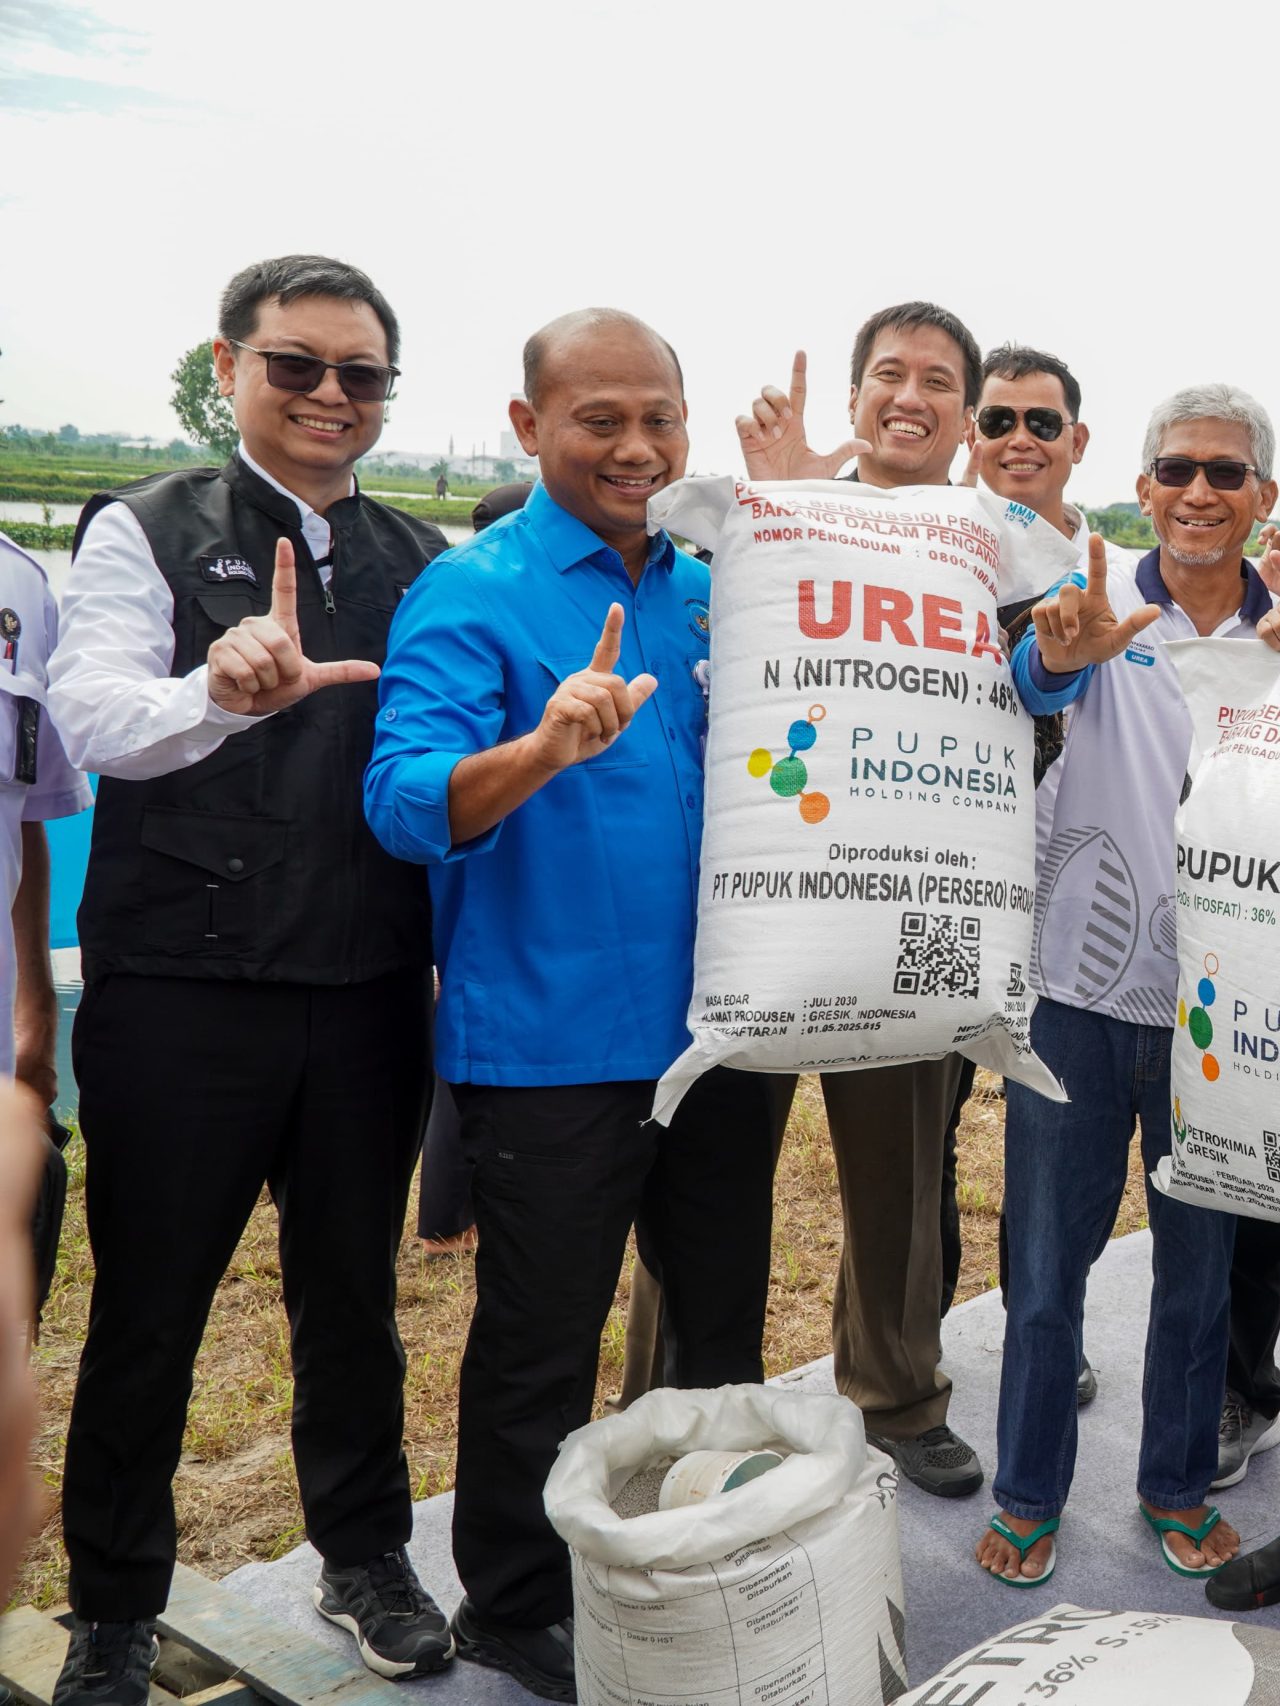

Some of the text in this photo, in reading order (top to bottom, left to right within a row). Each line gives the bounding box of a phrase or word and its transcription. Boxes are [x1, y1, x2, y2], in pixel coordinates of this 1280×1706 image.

[810, 501, 940, 524] BERSUBSIDI
[1007, 502, 1036, 523] MMM
[754, 528, 803, 543] NOMOR
[808, 528, 901, 554] PENGADUAN
[845, 516, 919, 538] DALAM
[798, 580, 1002, 665] UREA
[764, 657, 1018, 716] N (NITROGEN) 46%
[851, 727, 1016, 770] PUPUK
[851, 757, 1017, 798] INDONESIA
[850, 787, 1017, 814] HOLDING COMPANY
[829, 844, 929, 864] Diproduksi
[713, 873, 729, 900] PT
[731, 872, 793, 899] PUPUK
[799, 872, 912, 902] INDONESIA
[918, 873, 1006, 910] (PERSERO)
[1194, 893, 1241, 920] (FOSFAT)
[1251, 907, 1277, 925] 36%
[705, 994, 857, 1008] MASA EDAR JULI 2030
[701, 1010, 732, 1022] ALAMAT
[734, 1010, 795, 1022] PRODUSEN
[857, 1009, 917, 1019] INDONESIA
[807, 1022, 881, 1034] 01.05.2025.615
[793, 1055, 871, 1067] JANGAN
[1186, 1142, 1230, 1164] GRESIK
[1187, 1124, 1257, 1158] PETROKIMIA
[1177, 1170, 1215, 1185] PRODUSEN
[1216, 1170, 1256, 1188] FEBRUARI
[739, 1561, 790, 1594] Dibenamkan
[747, 1571, 792, 1601] Ditaburkan
[746, 1595, 798, 1628] Dibenamkan
[754, 1605, 799, 1635] Ditaburkan
[627, 1631, 648, 1642] Dasar
[755, 1662, 806, 1695] Dibenamkan
[761, 1673, 807, 1702] Ditaburkan
[1024, 1653, 1098, 1698] 36%
